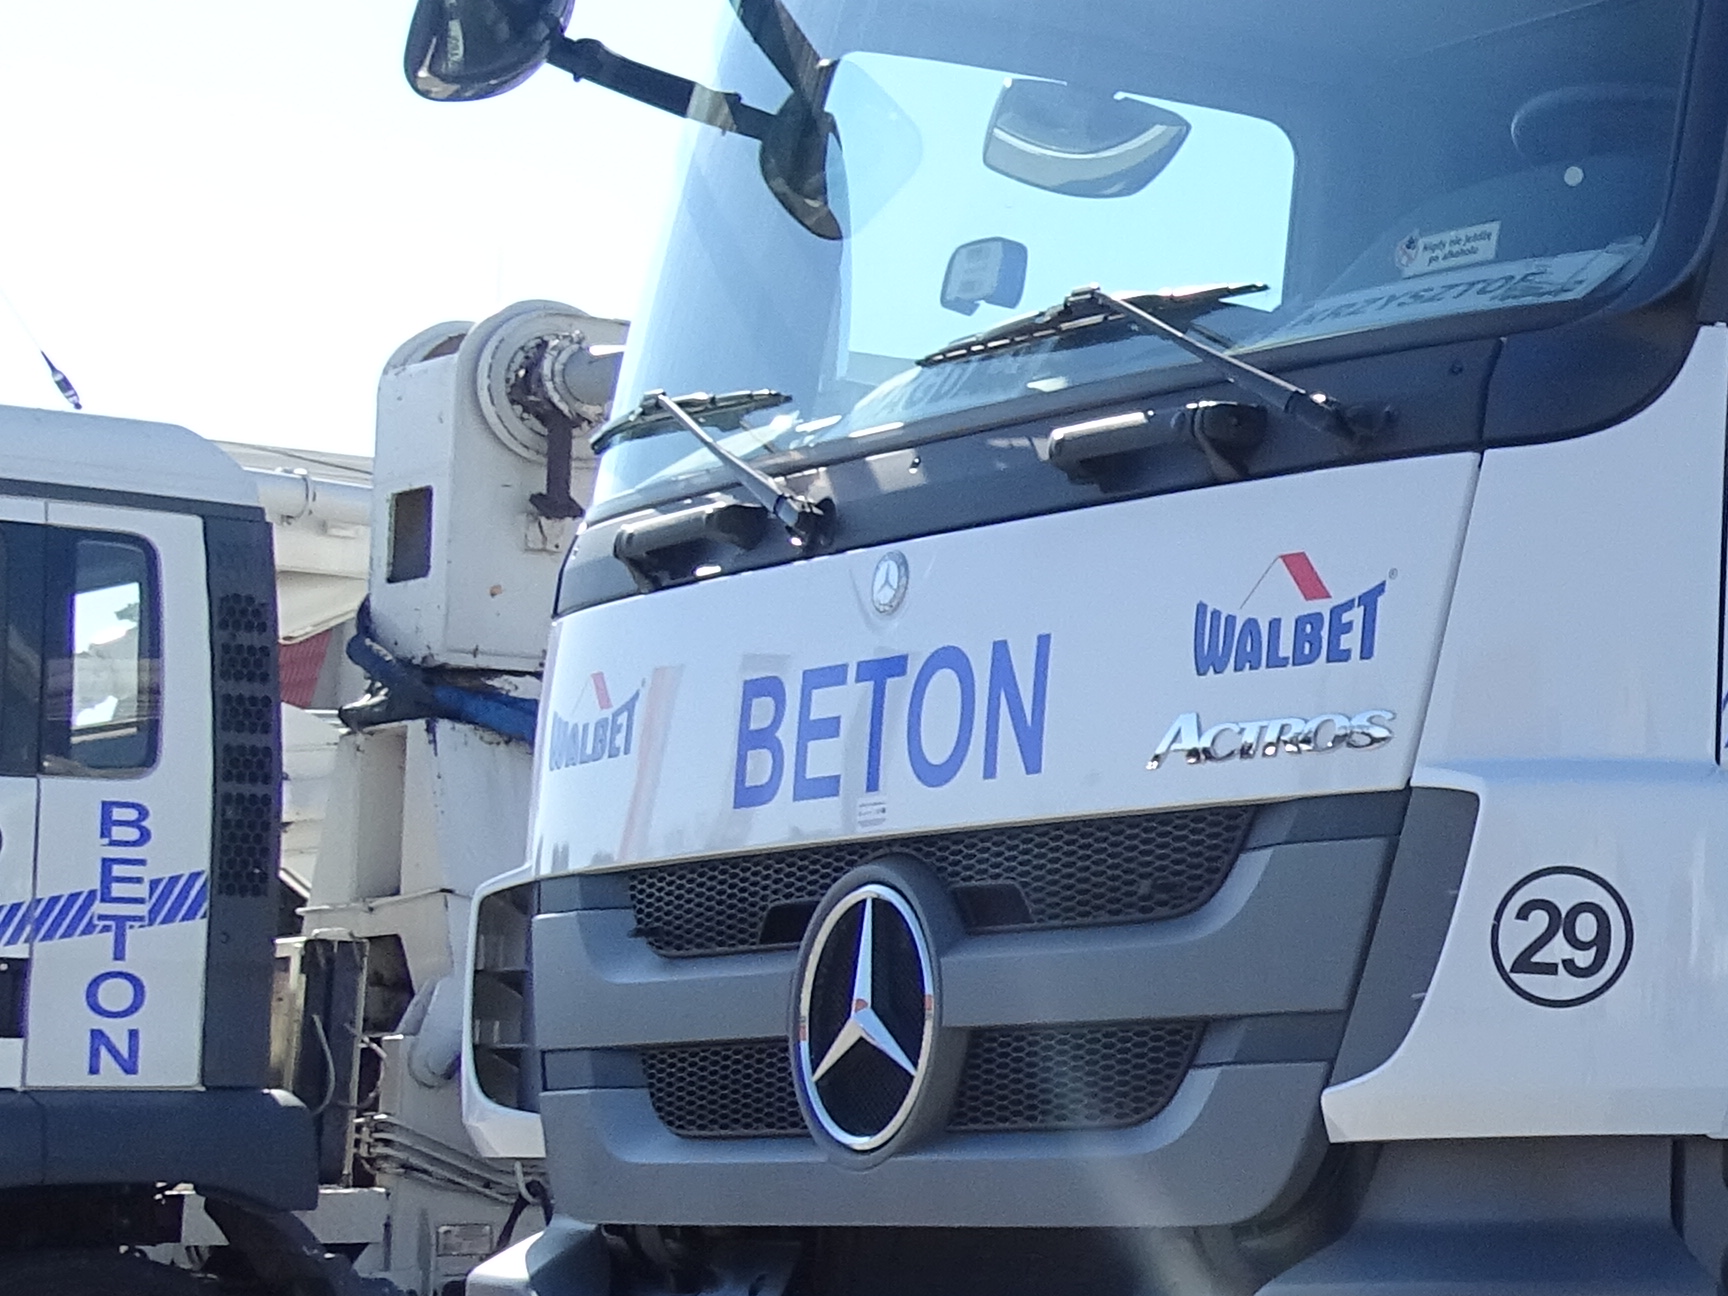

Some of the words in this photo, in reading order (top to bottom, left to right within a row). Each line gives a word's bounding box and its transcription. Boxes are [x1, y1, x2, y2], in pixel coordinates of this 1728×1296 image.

[1193, 579, 1387, 677] WALBET
[548, 688, 641, 771] WALBET
[732, 632, 1052, 810] BETON
[85, 800, 152, 1076] BETON
[1508, 898, 1612, 979] 29
